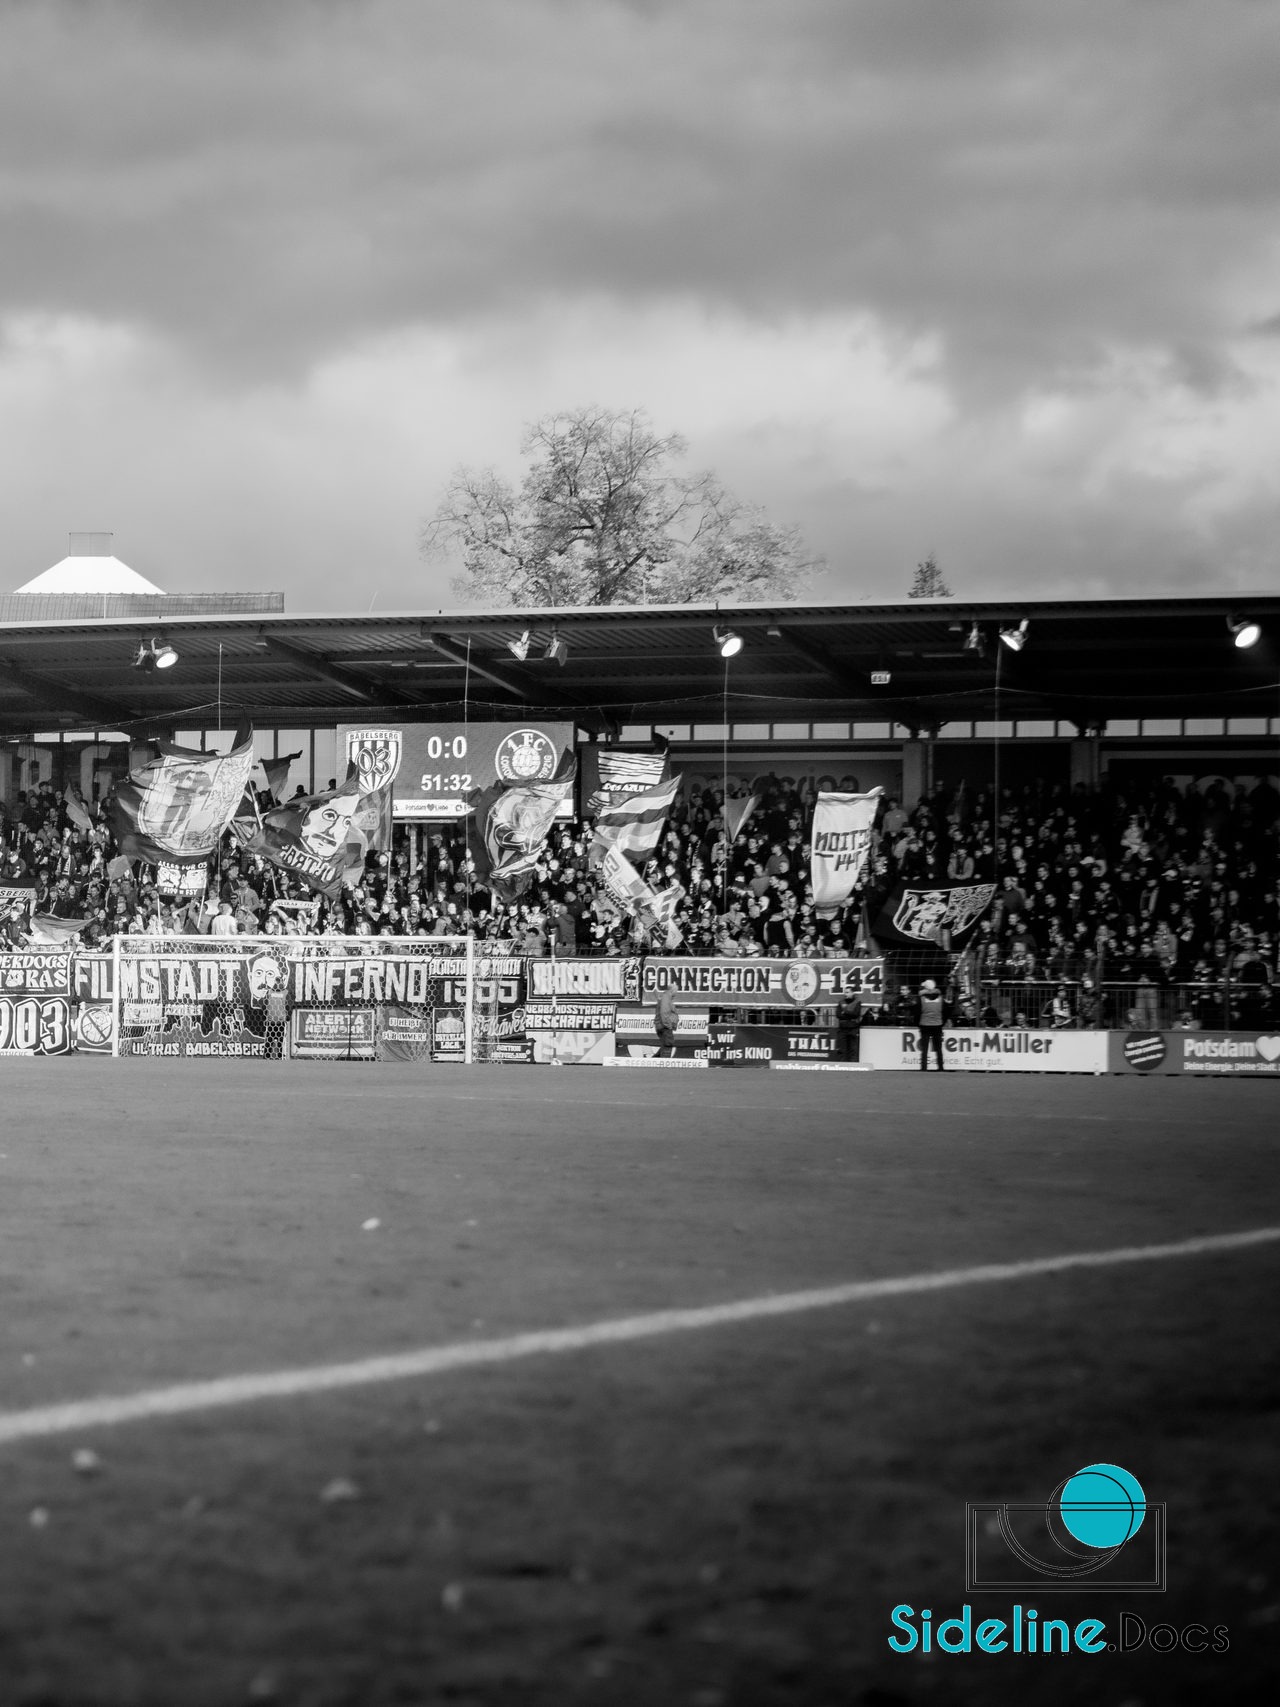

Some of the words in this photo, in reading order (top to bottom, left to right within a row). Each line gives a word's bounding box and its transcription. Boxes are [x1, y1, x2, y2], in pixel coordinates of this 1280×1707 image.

[350, 732, 398, 740] BABELSBERG
[428, 736, 467, 759] 0:0
[355, 747, 391, 777] 03
[421, 774, 472, 791] 51:32
[75, 960, 241, 1001] FILMSTADT
[294, 960, 428, 1004] INFERNO
[643, 966, 772, 993] CONNECTION
[829, 965, 883, 995] 144
[306, 1014, 364, 1025] ALERTA
[717, 1031, 736, 1043] wir
[788, 1037, 838, 1050] THALI
[901, 1032, 1053, 1054] Ren-Müller
[132, 1042, 179, 1055] ULTRAS
[744, 1047, 773, 1059] KINO
[1183, 1037, 1256, 1057] Potsdam
[926, 1056, 960, 1065] Sevice.
[964, 1056, 983, 1065] Echt
